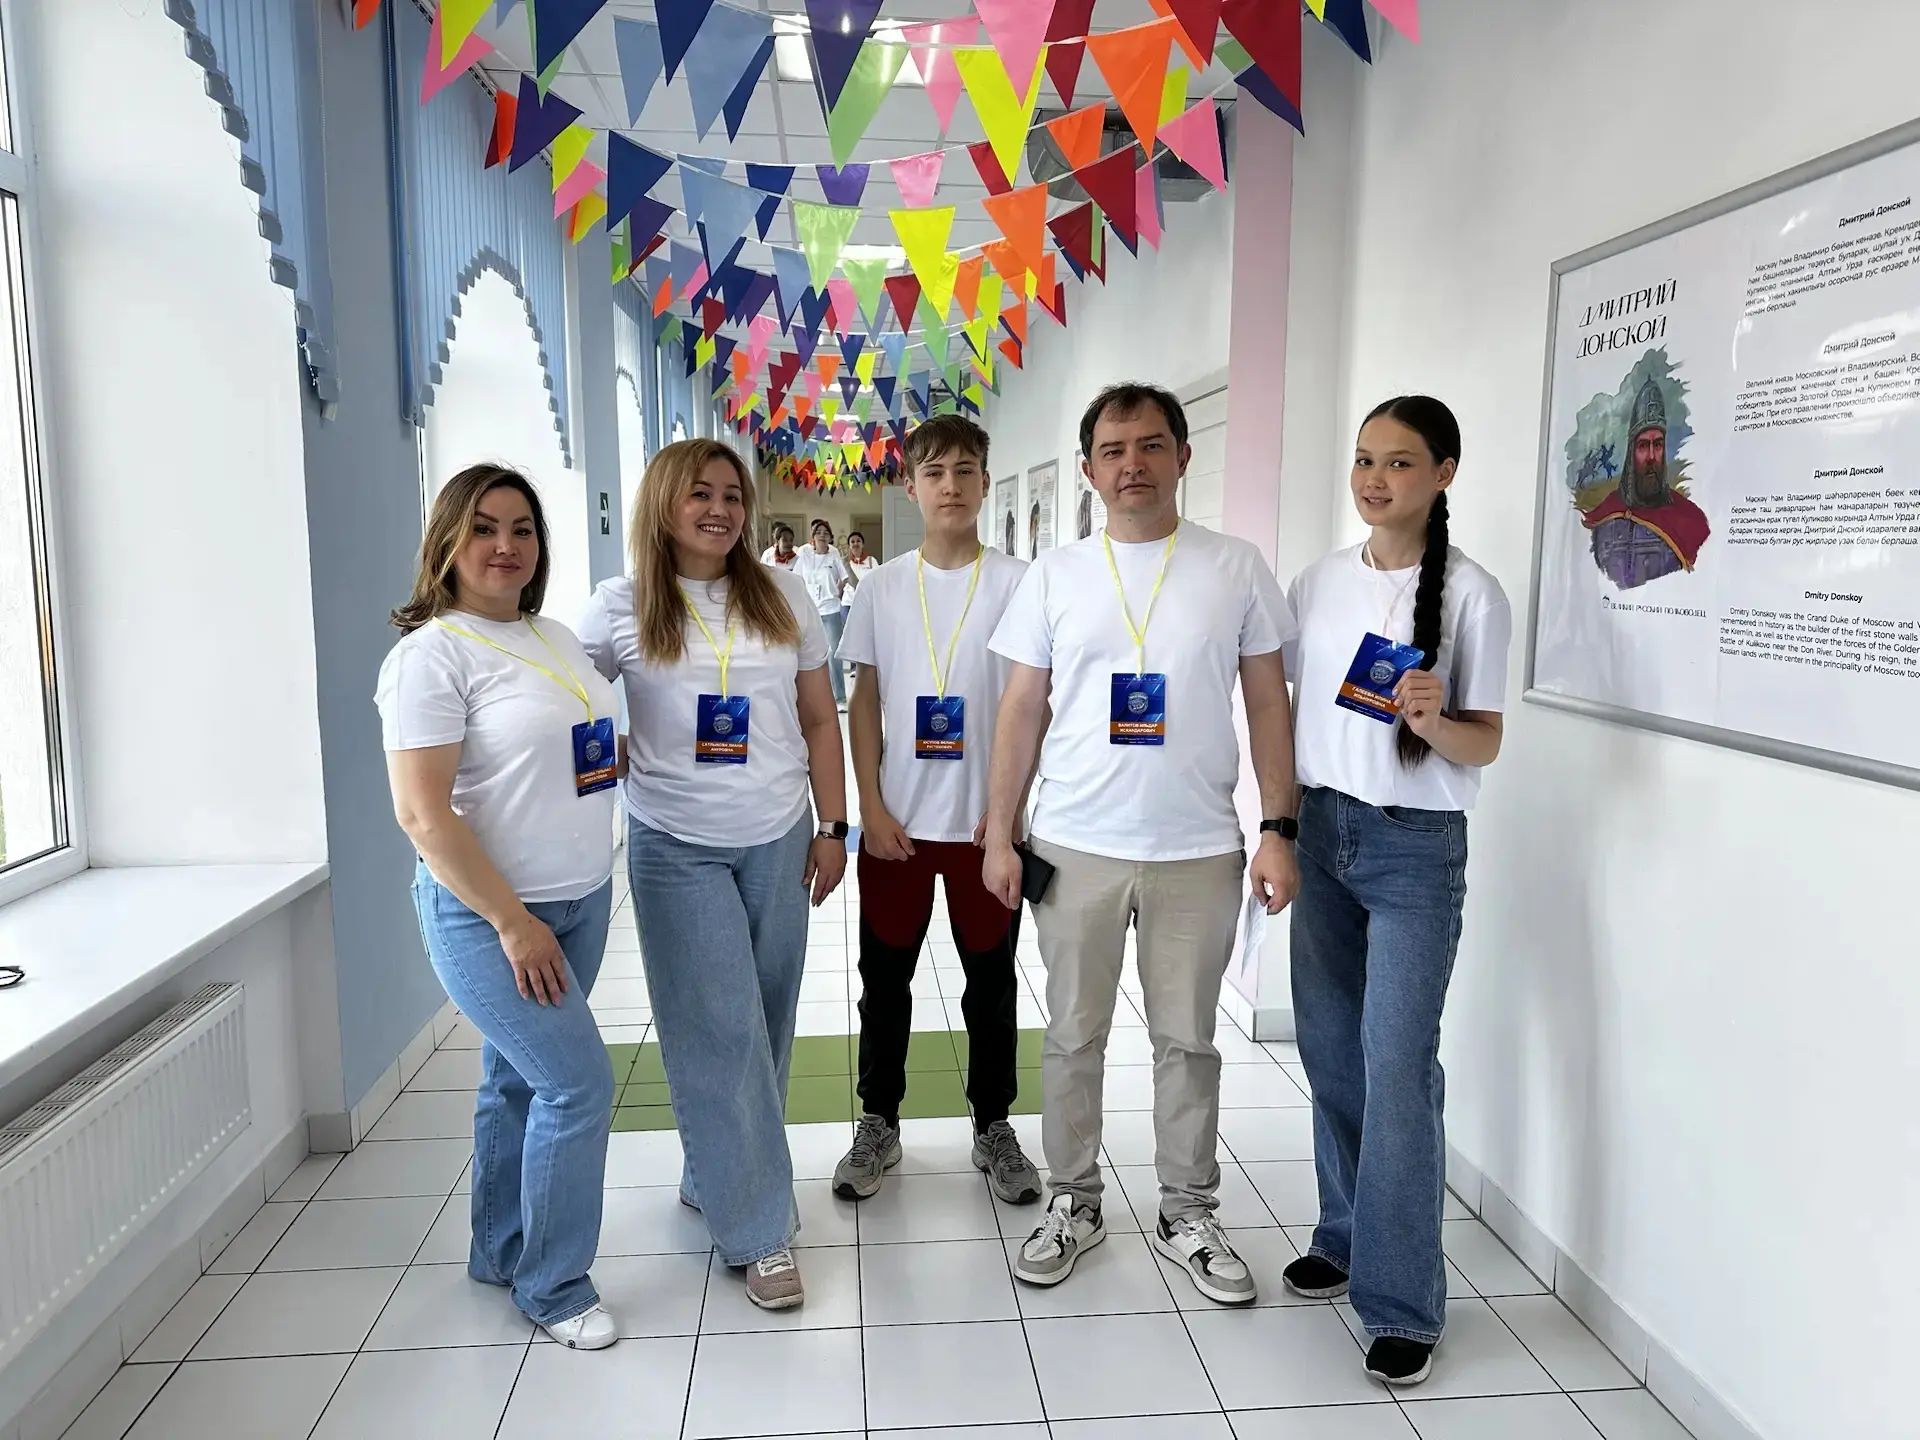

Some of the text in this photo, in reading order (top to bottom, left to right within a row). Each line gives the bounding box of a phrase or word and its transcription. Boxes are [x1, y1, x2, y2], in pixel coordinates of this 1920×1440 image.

[1839, 196, 1911, 228] Дмитрий Донской
[1794, 247, 1829, 262] Владимир
[1818, 267, 1842, 278] Алтын
[1828, 272, 1863, 286] осоронда
[1865, 268, 1879, 278] рус
[1579, 278, 1676, 327] ДМИТРИЙ
[1576, 314, 1666, 358] ДОНСКОЙ
[1824, 332, 1896, 354] Дмитрий Донской
[1737, 390, 1768, 400] строитель
[1773, 386, 1796, 396] первых
[1801, 380, 1835, 390] каменных
[1841, 376, 1857, 385] стен
[1874, 369, 1900, 379] башен
[1746, 377, 1773, 388] Великий
[1775, 376, 1793, 384] князь
[1796, 367, 1838, 380] Московский
[1736, 400, 1772, 410] победитель
[1775, 396, 1797, 405] войска
[1800, 390, 1828, 402] Золотой
[1831, 388, 1851, 398] Орды
[1868, 380, 1911, 393] Куликовом
[1735, 414, 1749, 422] реки
[1767, 409, 1780, 418] При
[1794, 402, 1831, 414] правлении
[1833, 397, 1875, 408] произошло
[1739, 422, 1765, 431] центром
[1772, 416, 1812, 427] Московском
[1814, 465, 1883, 478] Дмитрий Донской
[1801, 515, 1833, 524] Куликово
[1834, 514, 1867, 523] кырында
[1869, 513, 1893, 521] Алтын
[1896, 513, 1915, 521] Урда
[1729, 527, 1752, 535] буларак
[1804, 525, 1835, 534] Дмитрий
[1770, 537, 1791, 546] булган
[1804, 591, 1863, 603] Dmitry Donskoy
[1730, 608, 1749, 617] Dmitry
[1752, 609, 1777, 619] Donskoy
[1794, 612, 1804, 620] the
[1807, 613, 1827, 622] Grand
[1830, 615, 1848, 624] Duke
[1852, 617, 1860, 625] of
[1863, 618, 1894, 627] Moscow
[1720, 617, 1756, 626] remembered
[1765, 621, 1785, 631] history
[1808, 625, 1830, 634] builder
[1832, 627, 1839, 635] of
[1842, 627, 1853, 636] the
[1856, 628, 1871, 637] first
[1874, 631, 1895, 640] stone
[1898, 633, 1918, 641] walls
[1746, 640, 1770, 648] Kulikovo
[1788, 644, 1798, 652] the
[1801, 646, 1814, 654] Don
[1836, 649, 1860, 661] During
[1864, 652, 1875, 661] his
[1879, 654, 1900, 665] reign,
[1904, 657, 1916, 665] the
[1796, 634, 1813, 643] victor
[1831, 638, 1841, 646] the
[1844, 639, 1866, 648] forces
[1869, 641, 1876, 649] of
[1878, 642, 1891, 651] the
[1720, 647, 1739, 655] Russian
[1741, 650, 1756, 658] lands
[1784, 655, 1803, 663] center
[1812, 658, 1822, 666] the
[1823, 660, 1862, 672] principality
[1864, 664, 1871, 672] of
[1874, 665, 1905, 676] Moscow
